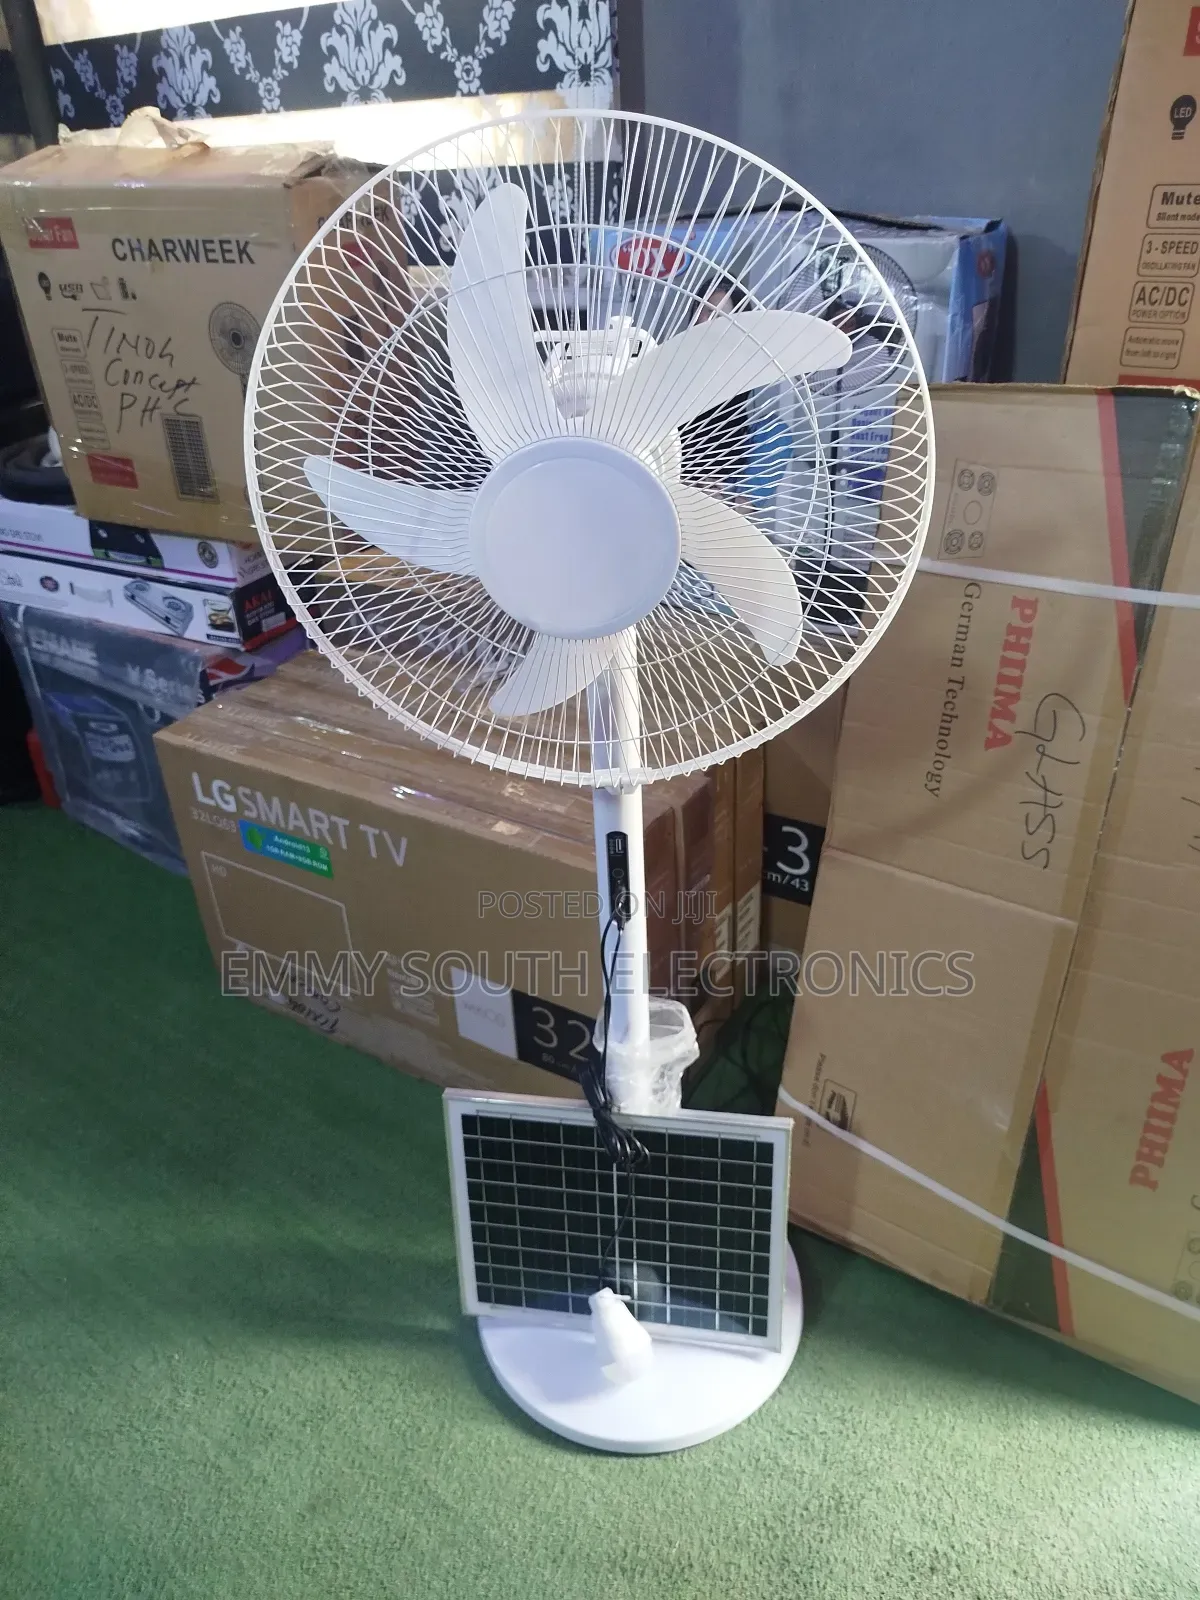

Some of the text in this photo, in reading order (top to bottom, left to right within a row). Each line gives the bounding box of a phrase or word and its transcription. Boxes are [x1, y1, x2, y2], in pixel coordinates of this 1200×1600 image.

[1174, 107, 1192, 118] LED
[1161, 191, 1200, 206] Mute
[1156, 212, 1178, 222] Silent
[112, 238, 256, 264] CHARWEEK
[1135, 286, 1190, 307] AC/DC
[1131, 309, 1158, 318] POWER
[984, 595, 1039, 752] PHIIMA
[924, 581, 983, 798] German Technology
[191, 771, 408, 868] LG SMART TV
[532, 1005, 591, 1062] 32
[1128, 1047, 1196, 1192] PHIIMA
